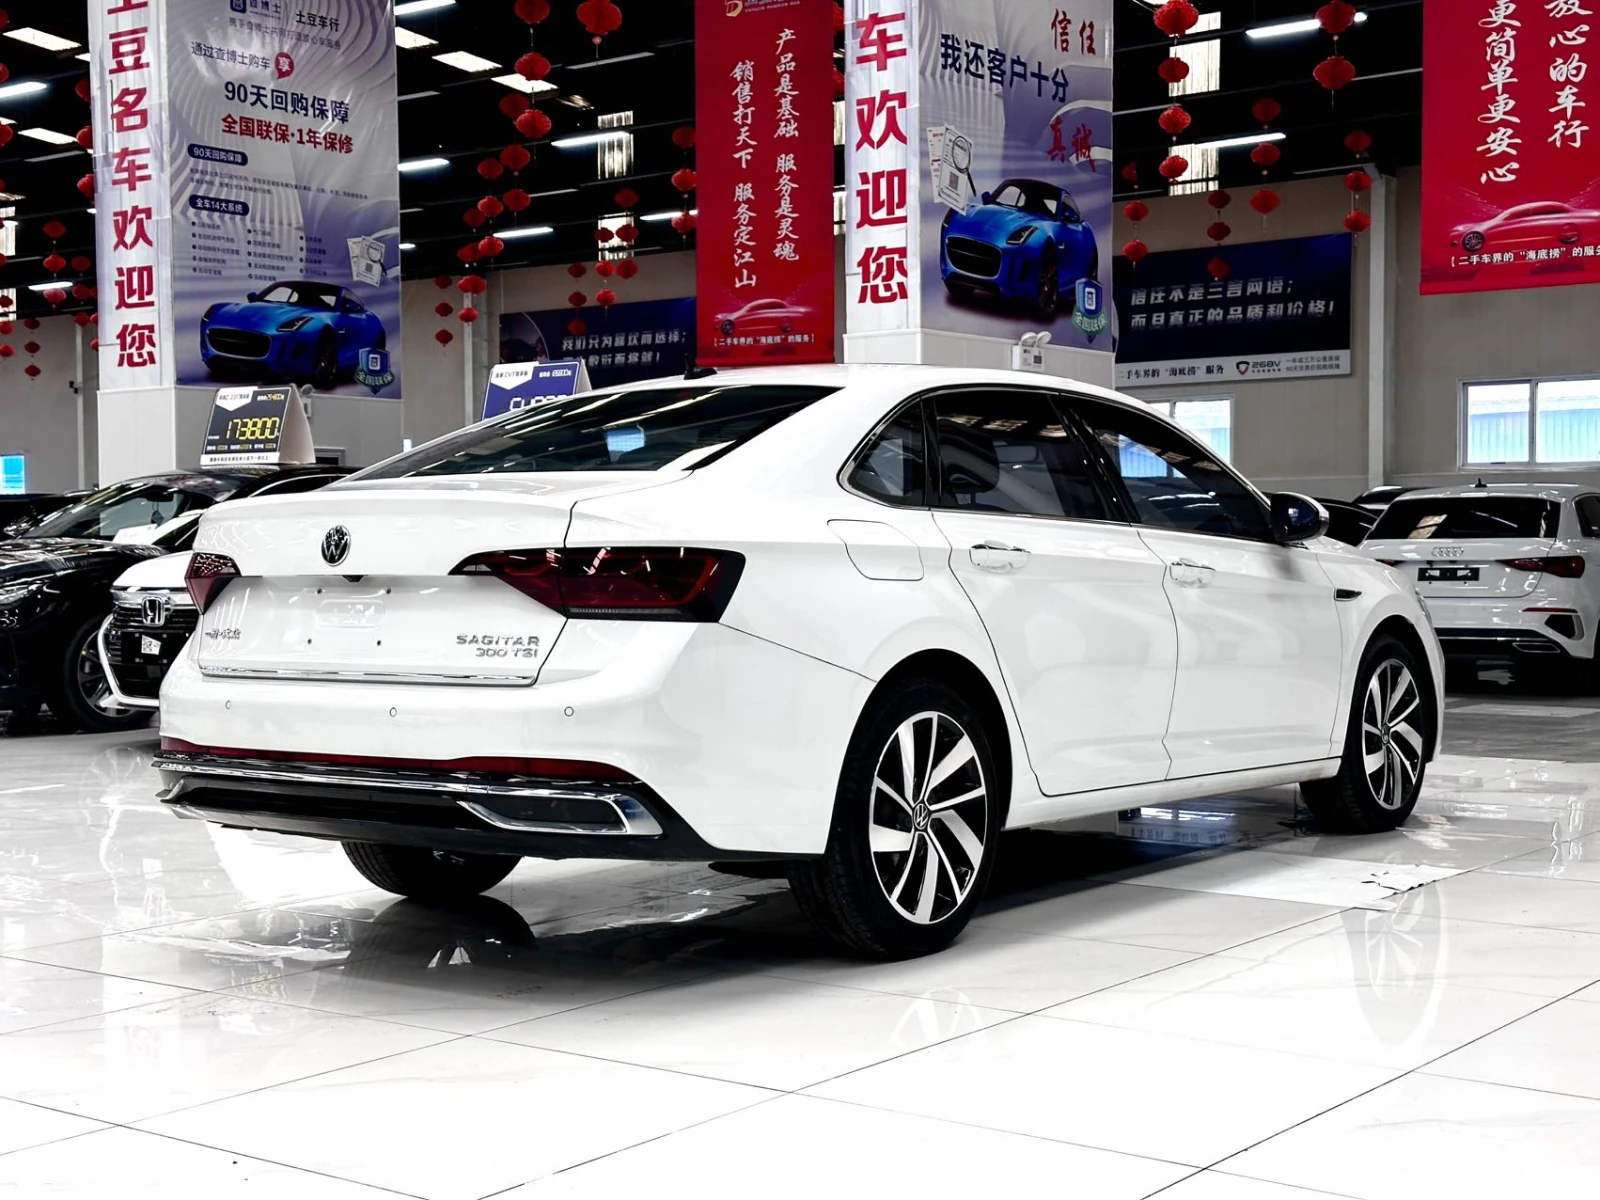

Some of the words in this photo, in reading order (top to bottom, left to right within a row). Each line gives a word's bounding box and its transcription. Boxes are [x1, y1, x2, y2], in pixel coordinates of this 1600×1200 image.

[295, 10, 339, 32] 土豆车行
[1051, 8, 1096, 55] 信任
[190, 41, 271, 70] 通过查博士购车
[278, 56, 290, 73] 享
[940, 33, 1069, 103] 我还客户十分
[1544, 0, 1593, 149] 放心的车行
[224, 81, 350, 124] 90天回购保障
[773, 28, 800, 139] 产品是基础
[1476, 0, 1522, 184] 更简单更安心
[729, 60, 758, 169] 销售打天下
[193, 147, 243, 164] 90天回购保障
[855, 11, 908, 304] 车欢迎您
[195, 197, 243, 214] 全车14大系统
[773, 153, 800, 261] 服务是灵魂
[732, 182, 758, 288] 服务定江山
[1252, 360, 1281, 369] 268V
[226, 417, 280, 440] 173800
[456, 634, 540, 647] SAGITAR
[475, 647, 508, 658] 300
[511, 648, 538, 658] TSI
